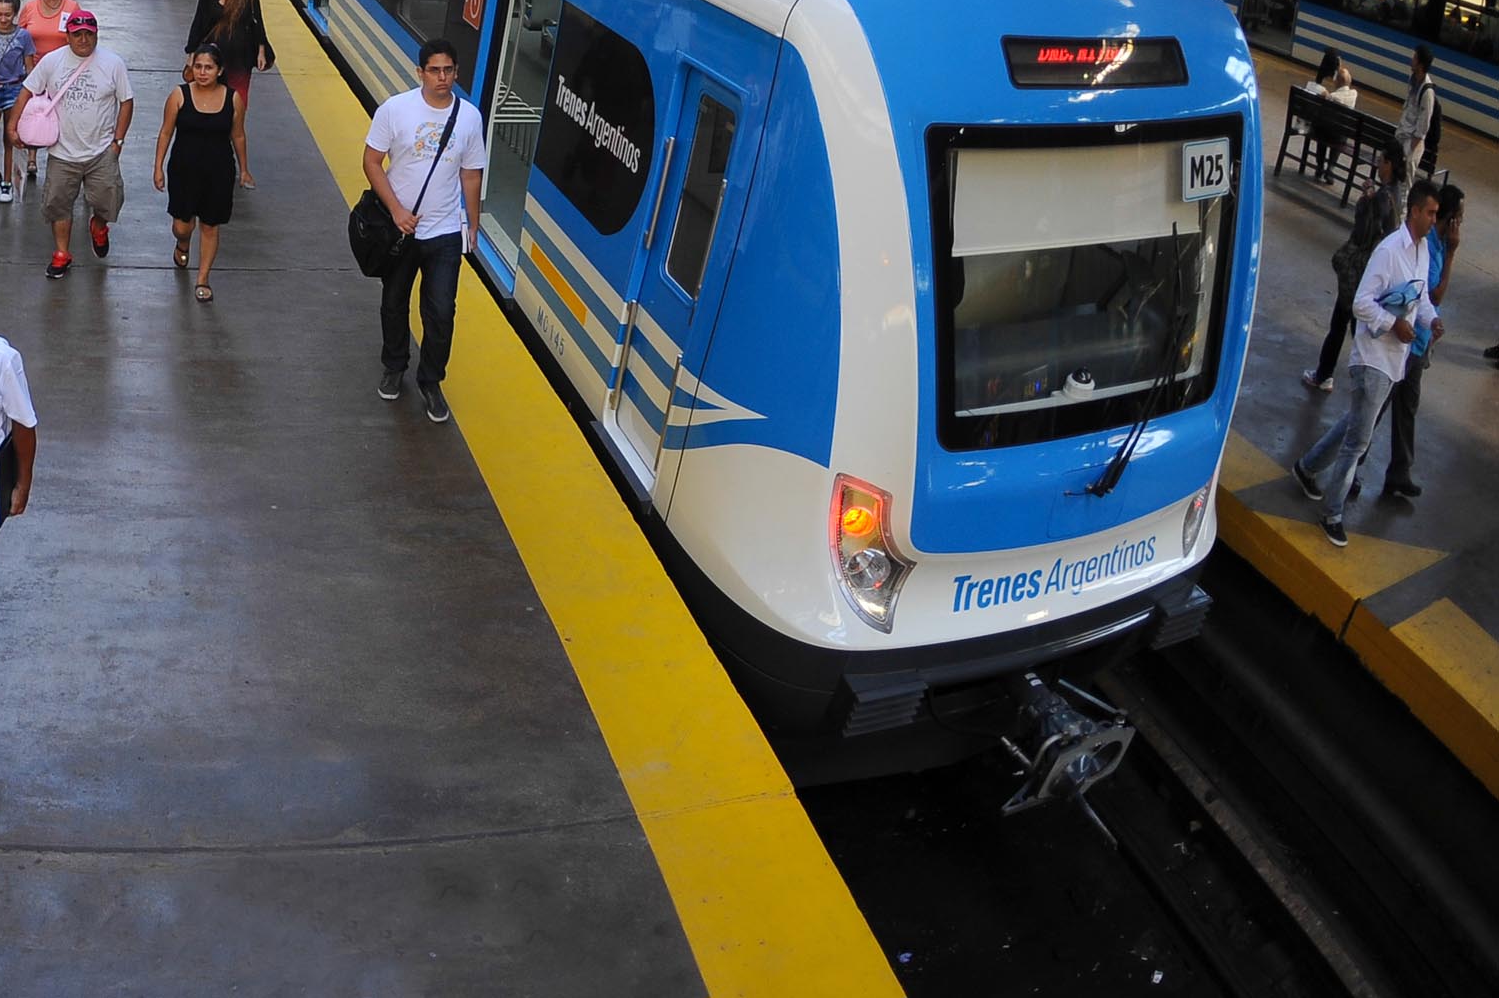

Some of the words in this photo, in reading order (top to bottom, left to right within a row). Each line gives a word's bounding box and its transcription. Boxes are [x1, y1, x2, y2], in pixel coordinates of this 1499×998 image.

[555, 74, 588, 127] Trenes
[584, 101, 641, 174] Argentinos
[1190, 153, 1224, 189] M25
[953, 569, 1043, 613] Trenes
[1044, 536, 1156, 596] Argentinos
